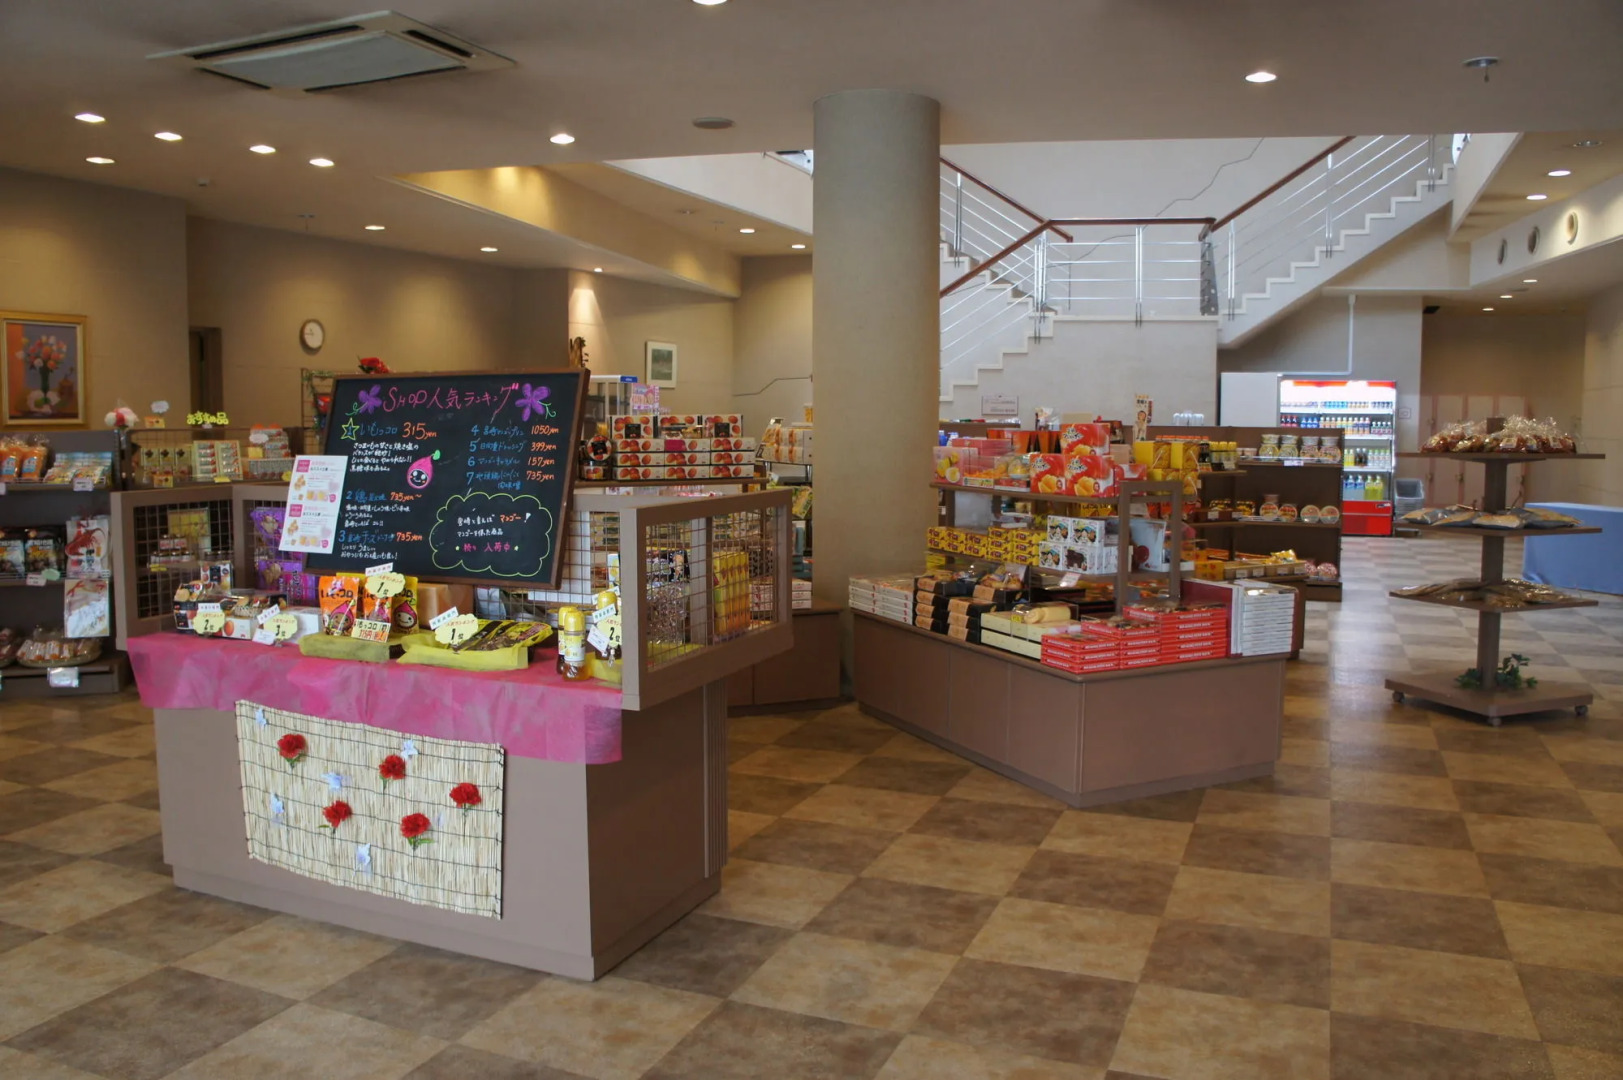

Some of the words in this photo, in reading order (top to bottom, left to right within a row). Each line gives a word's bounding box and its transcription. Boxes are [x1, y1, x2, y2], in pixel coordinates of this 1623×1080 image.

[186, 410, 229, 425] おすすめ品
[471, 424, 480, 436] 4
[531, 424, 559, 437] 1050yen
[469, 438, 480, 452] 5
[530, 441, 557, 452] 399yen
[467, 456, 475, 467] 6
[527, 456, 555, 468] 157yen
[466, 471, 474, 485] 7
[526, 470, 555, 483] 735yen
[346, 490, 353, 500] 2
[500, 512, 522, 523] マンゴー
[338, 530, 346, 543] 3
[396, 531, 423, 542] 735yen
